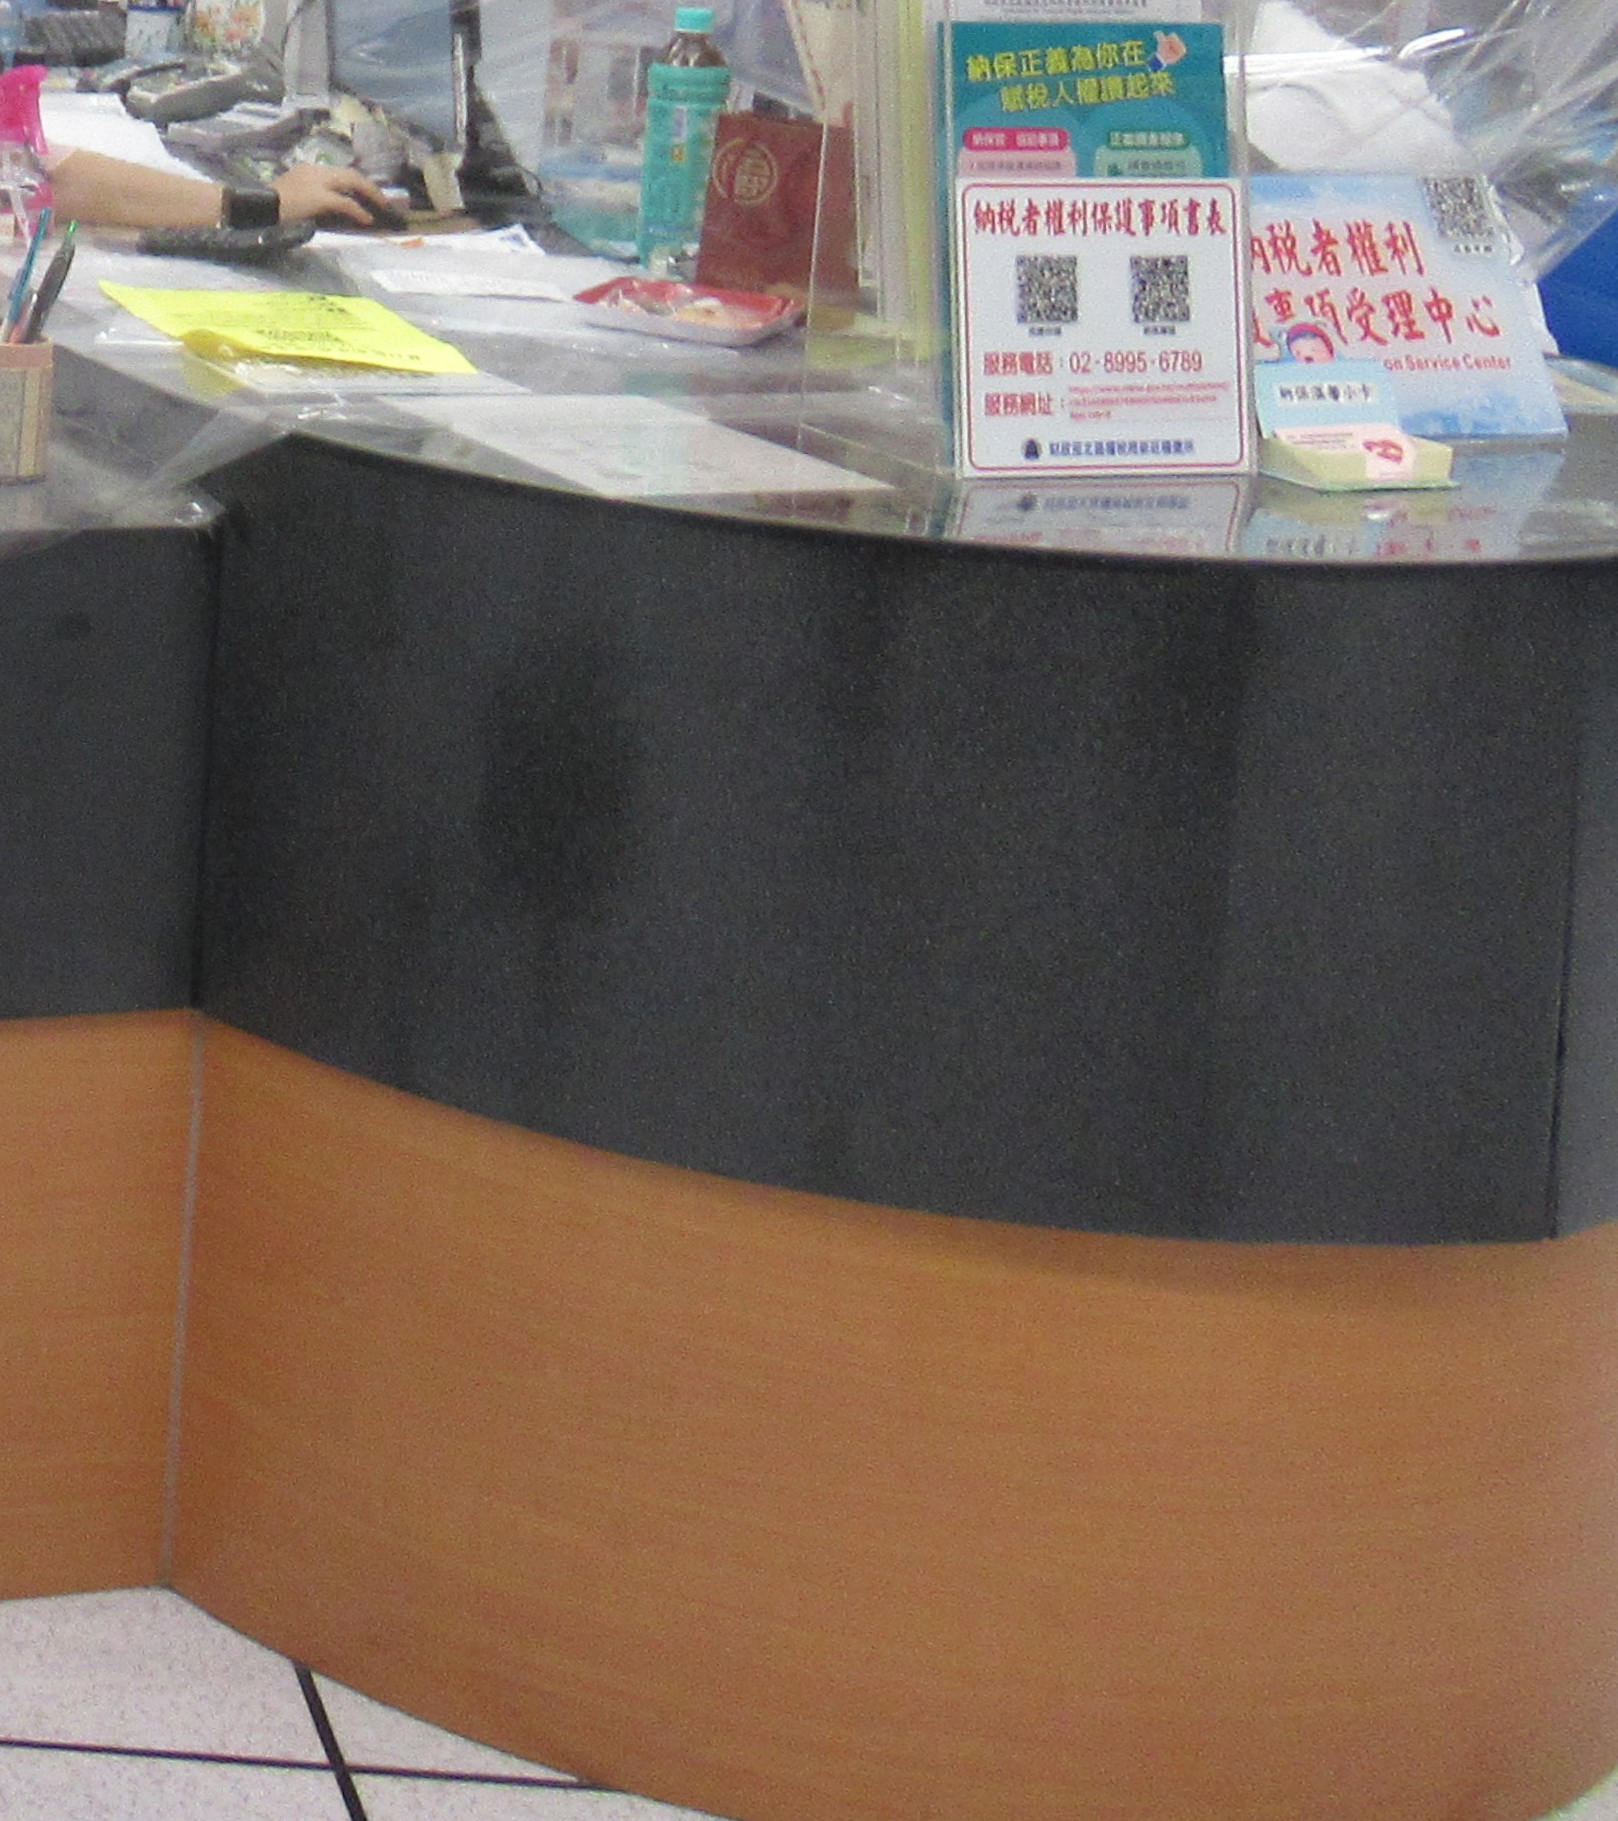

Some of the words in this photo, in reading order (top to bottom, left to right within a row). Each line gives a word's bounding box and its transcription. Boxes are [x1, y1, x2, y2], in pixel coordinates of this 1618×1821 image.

[1253, 286, 1501, 349] 事項受理中心
[1405, 354, 1460, 372] Service
[1463, 354, 1512, 371] Center
